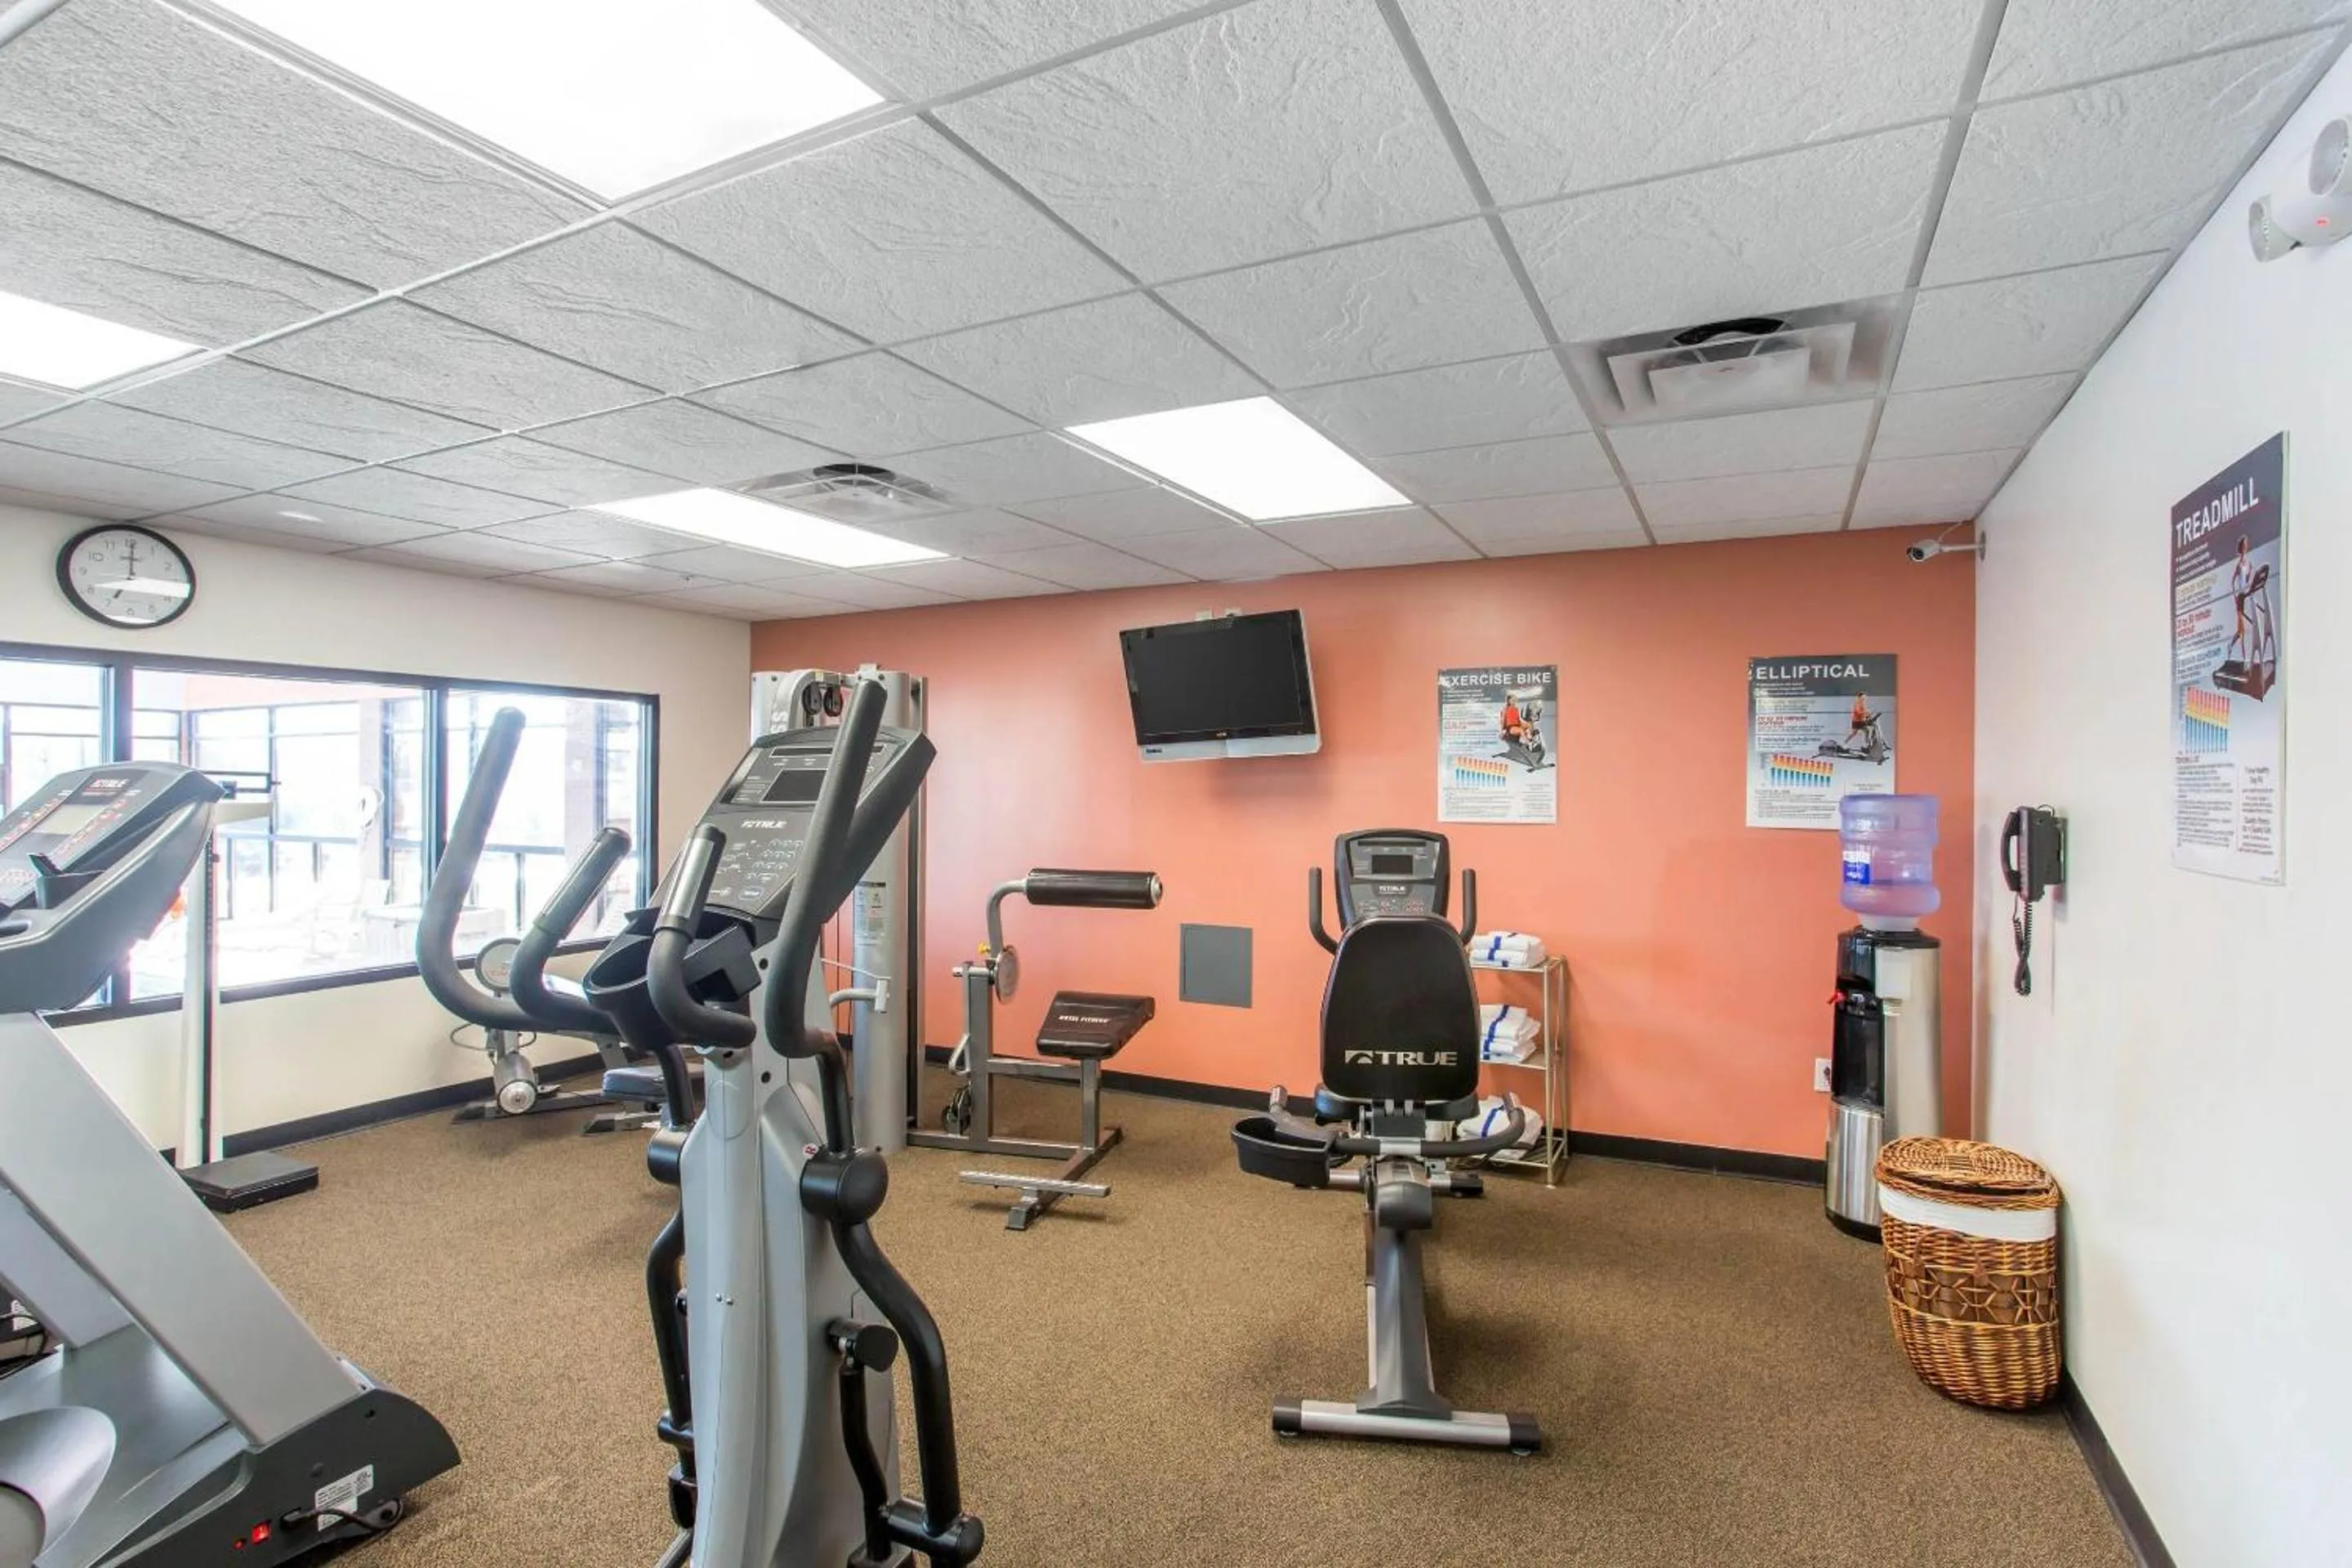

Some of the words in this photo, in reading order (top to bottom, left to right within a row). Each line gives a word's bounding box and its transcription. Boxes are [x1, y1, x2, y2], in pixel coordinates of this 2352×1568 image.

[2176, 478, 2260, 549] TREADMILL
[105, 540, 116, 550] 11
[89, 552, 104, 562] 10
[1517, 672, 1552, 684] BIKE
[1756, 664, 1870, 679] ELLIPTICAL
[1374, 1050, 1458, 1066] TRUE
